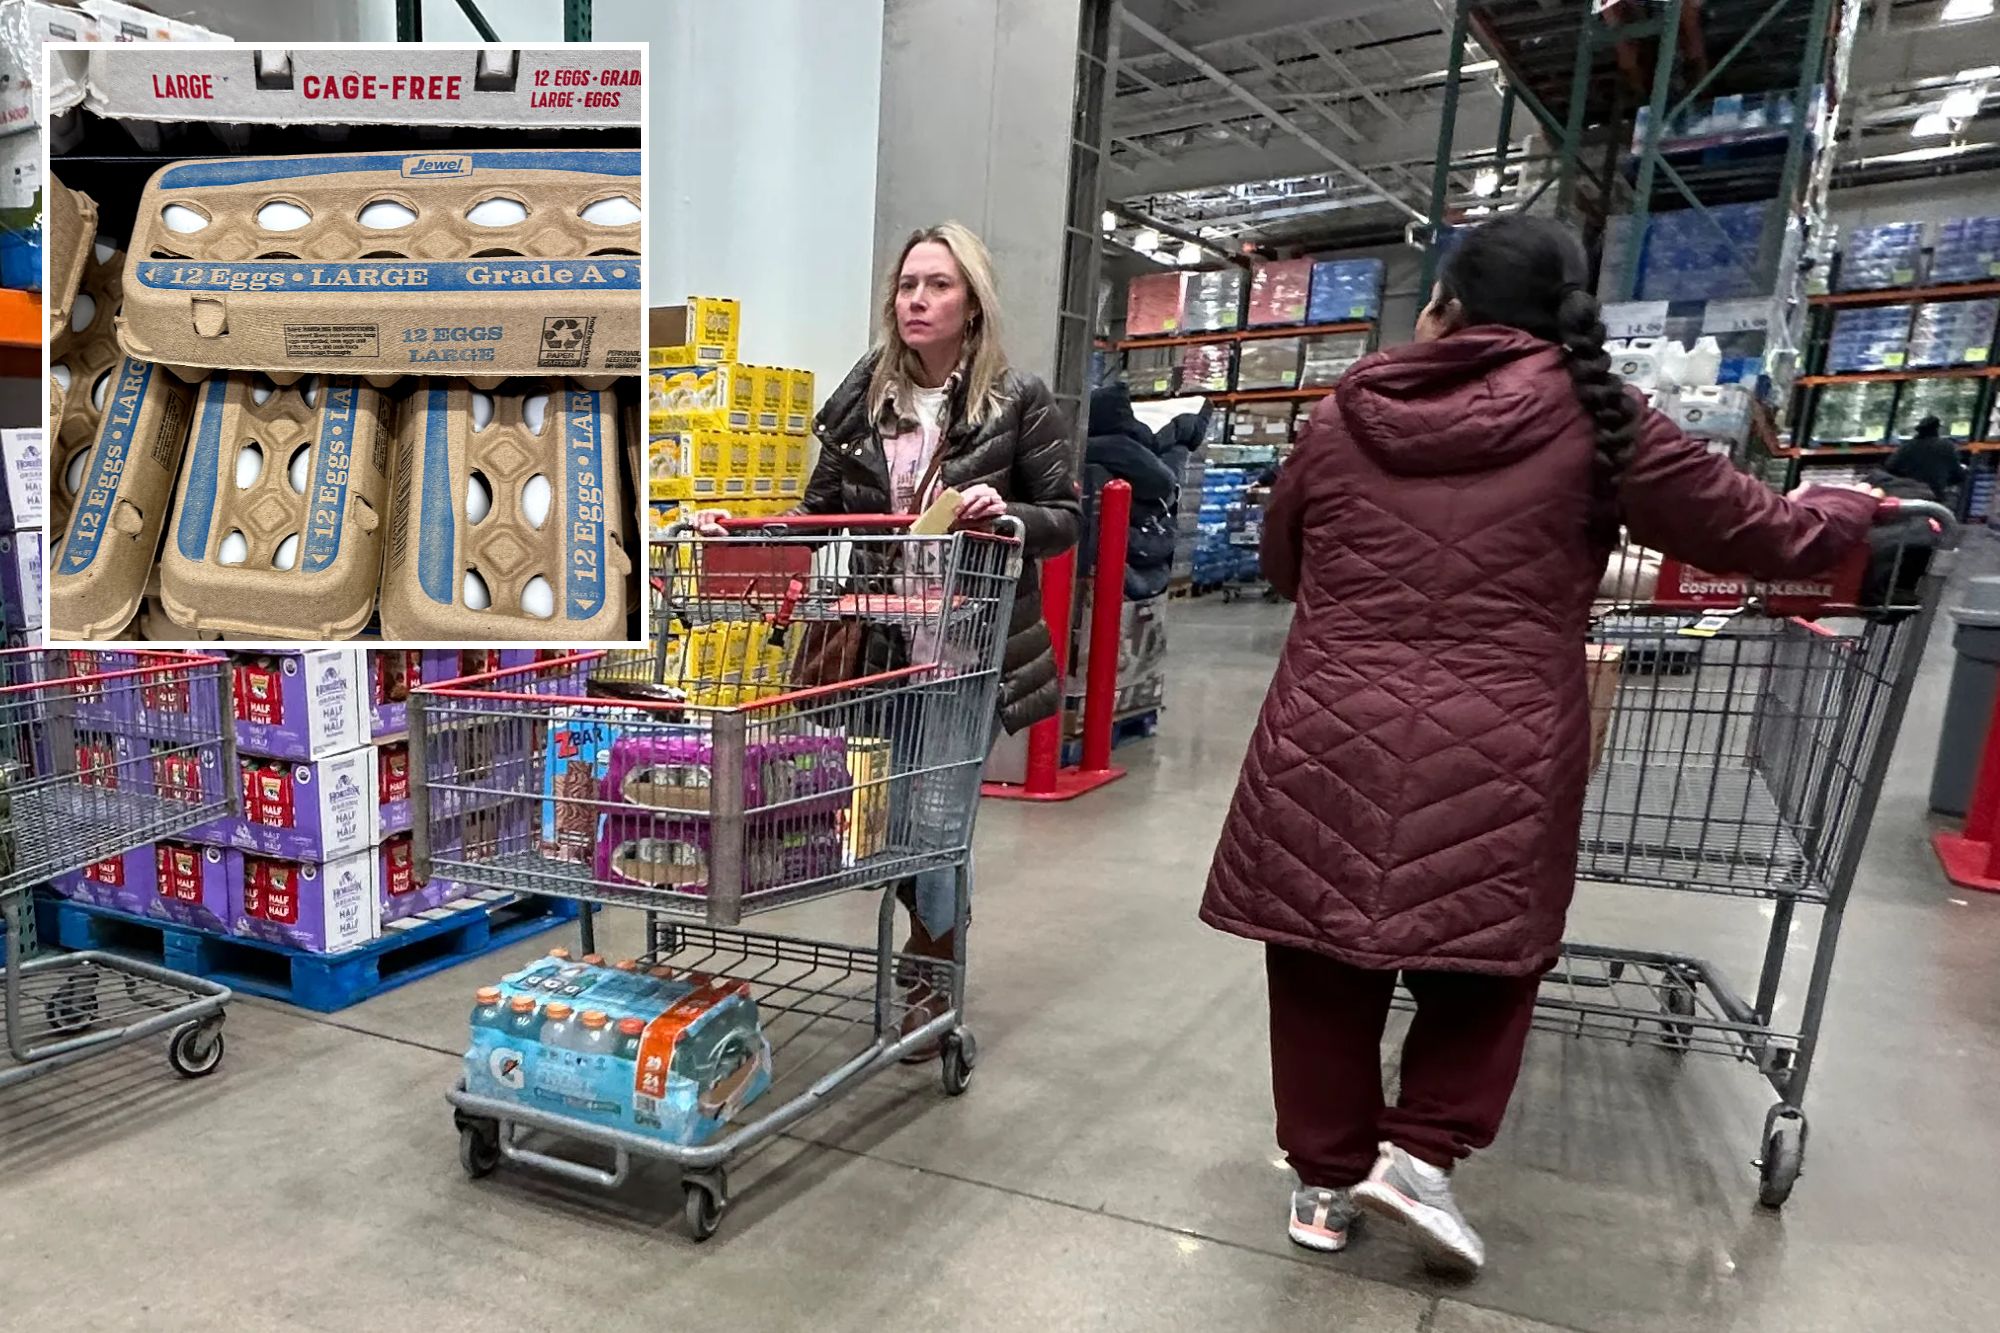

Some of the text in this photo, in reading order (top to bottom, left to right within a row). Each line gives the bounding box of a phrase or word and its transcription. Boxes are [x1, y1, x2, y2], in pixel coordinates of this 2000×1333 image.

[534, 70, 549, 87] 12
[554, 70, 591, 87] EGGS
[152, 74, 214, 99] LARGE
[303, 75, 463, 100] CAGE-FREE
[530, 92, 621, 109] LARGE EGGS
[413, 158, 463, 173] Jewel
[170, 264, 607, 291] 12 Eggs LARGE Grade A
[401, 326, 503, 343] 12 EGGS
[407, 347, 496, 363] LARGE
[112, 360, 148, 427] LARG
[571, 390, 594, 451] LAR
[89, 444, 124, 510] Eggs
[319, 439, 351, 506] Eggs
[574, 471, 603, 545] Eggs
[78, 511, 101, 543] 12
[314, 508, 336, 539] 12
[573, 552, 597, 583] 12
[1679, 582, 1737, 595] COSTCO
[250, 702, 271, 714] HALF
[323, 705, 343, 718] HALF
[324, 720, 344, 733] HALF
[262, 804, 282, 816] HALF
[335, 811, 356, 823] HALF
[262, 817, 283, 828] HALF
[336, 824, 357, 838] HALF
[176, 878, 195, 888] HALF
[177, 890, 196, 900] HALF
[268, 894, 290, 904] HALF
[268, 906, 290, 917] HALF
[339, 906, 359, 918] HALF
[340, 919, 359, 933] HALF
